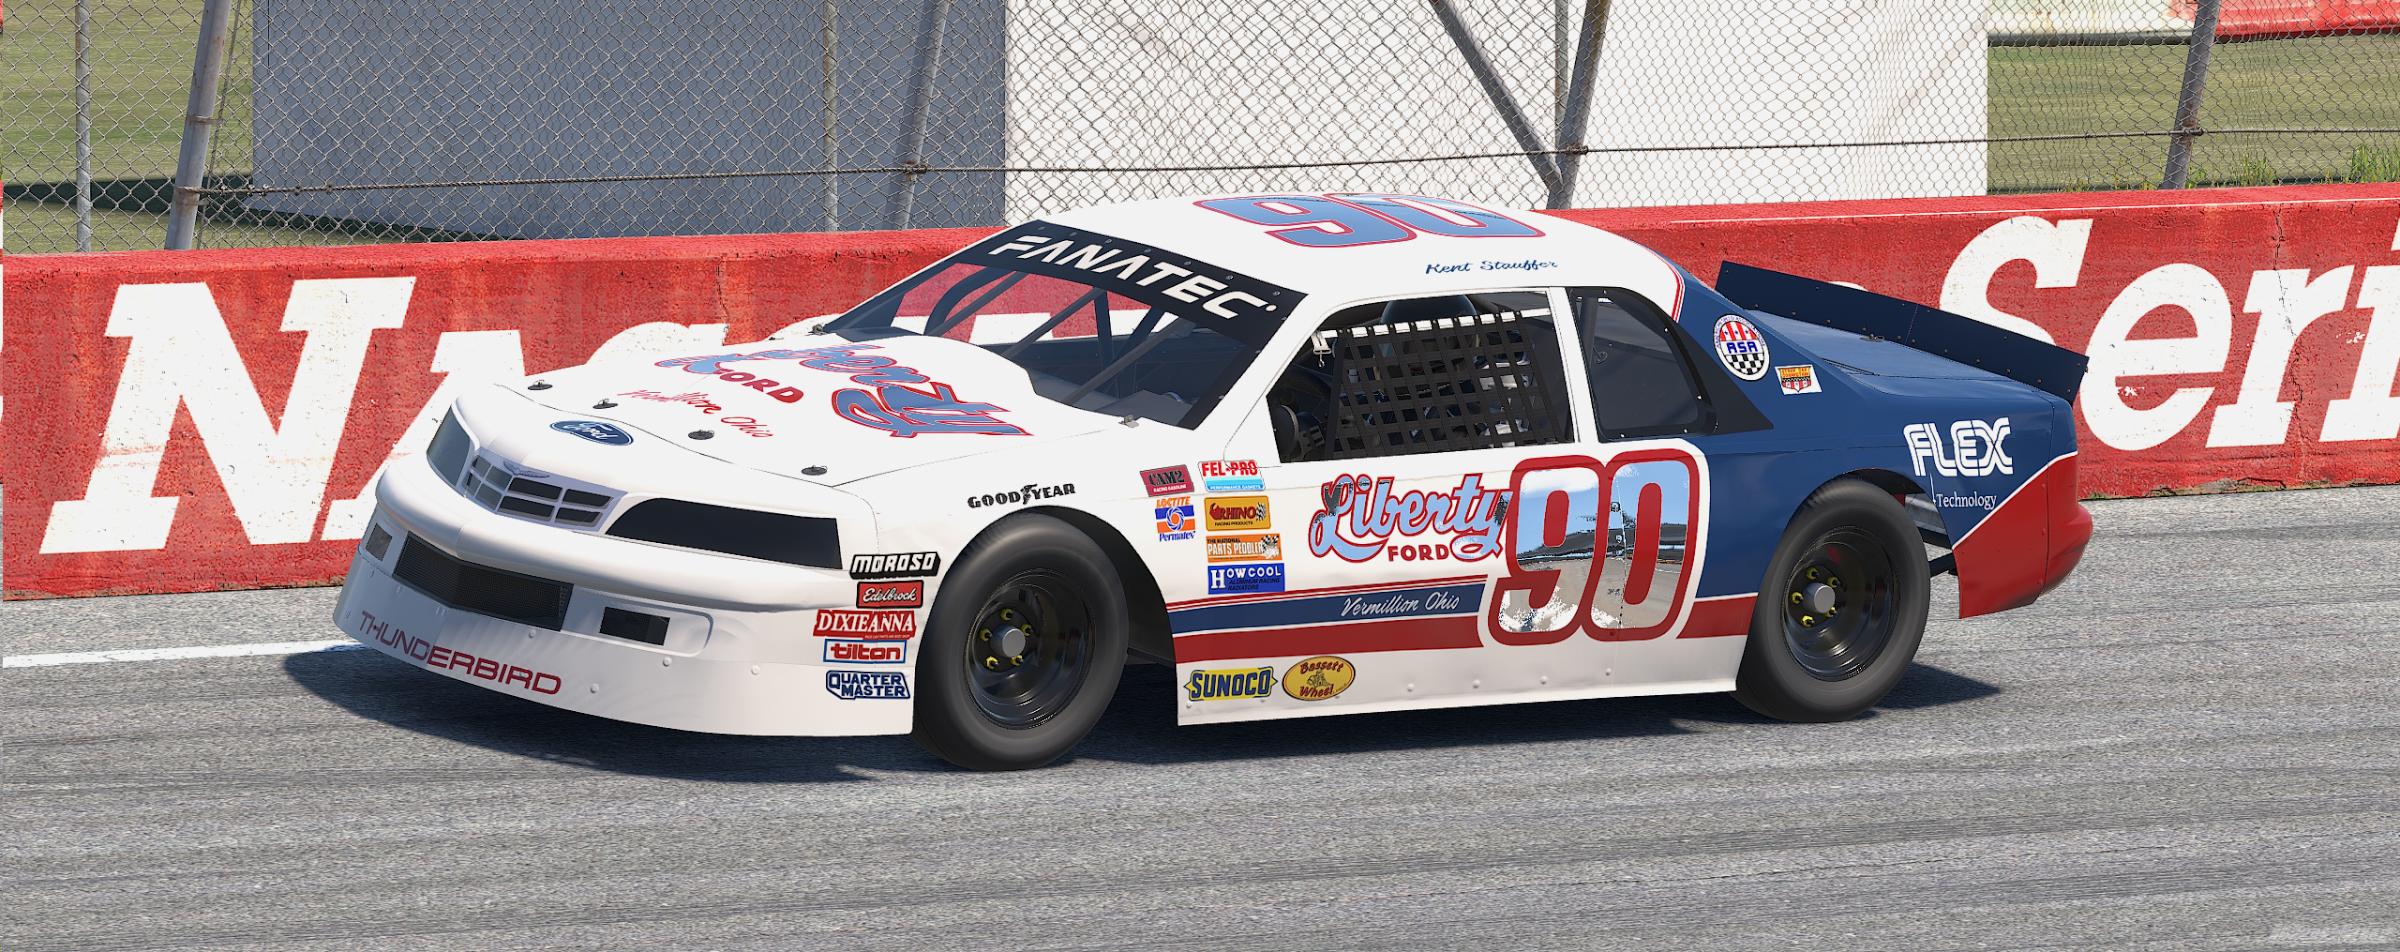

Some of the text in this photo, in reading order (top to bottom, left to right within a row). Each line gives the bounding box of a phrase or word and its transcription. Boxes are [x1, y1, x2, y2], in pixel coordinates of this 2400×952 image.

[1192, 193, 1547, 248] 90
[1426, 260, 1558, 274] Kent Stauffer
[989, 235, 1272, 319] FANATEC
[1726, 341, 1759, 354] ASA
[1903, 417, 2014, 477] FLEX
[1149, 470, 1185, 487] CAM2
[967, 483, 1076, 508] GOODYEAR
[1156, 496, 1191, 508] LOCTITE
[1936, 491, 1997, 510] Technology
[1214, 505, 1257, 521] RHINO
[1308, 473, 1515, 564] Liberty
[1159, 531, 1195, 542] Permatex
[1207, 542, 1264, 556] PARTS PEDDLER
[1387, 545, 1450, 561] FORD
[1487, 448, 1700, 647] 90
[851, 552, 938, 574] MOROSO
[863, 587, 917, 603] Edelbrock
[1340, 591, 1460, 616] Vermillion Ohio
[816, 612, 914, 633] DIXIEANNA
[359, 610, 562, 696] THUNDERBIRD
[830, 643, 901, 660] tilton
[1300, 660, 1344, 675] Bassett
[828, 672, 902, 689] QUARTER
[1191, 669, 1271, 698] SUNOCO
[841, 684, 906, 697] MASTER
[1299, 683, 1334, 697] Wheel
